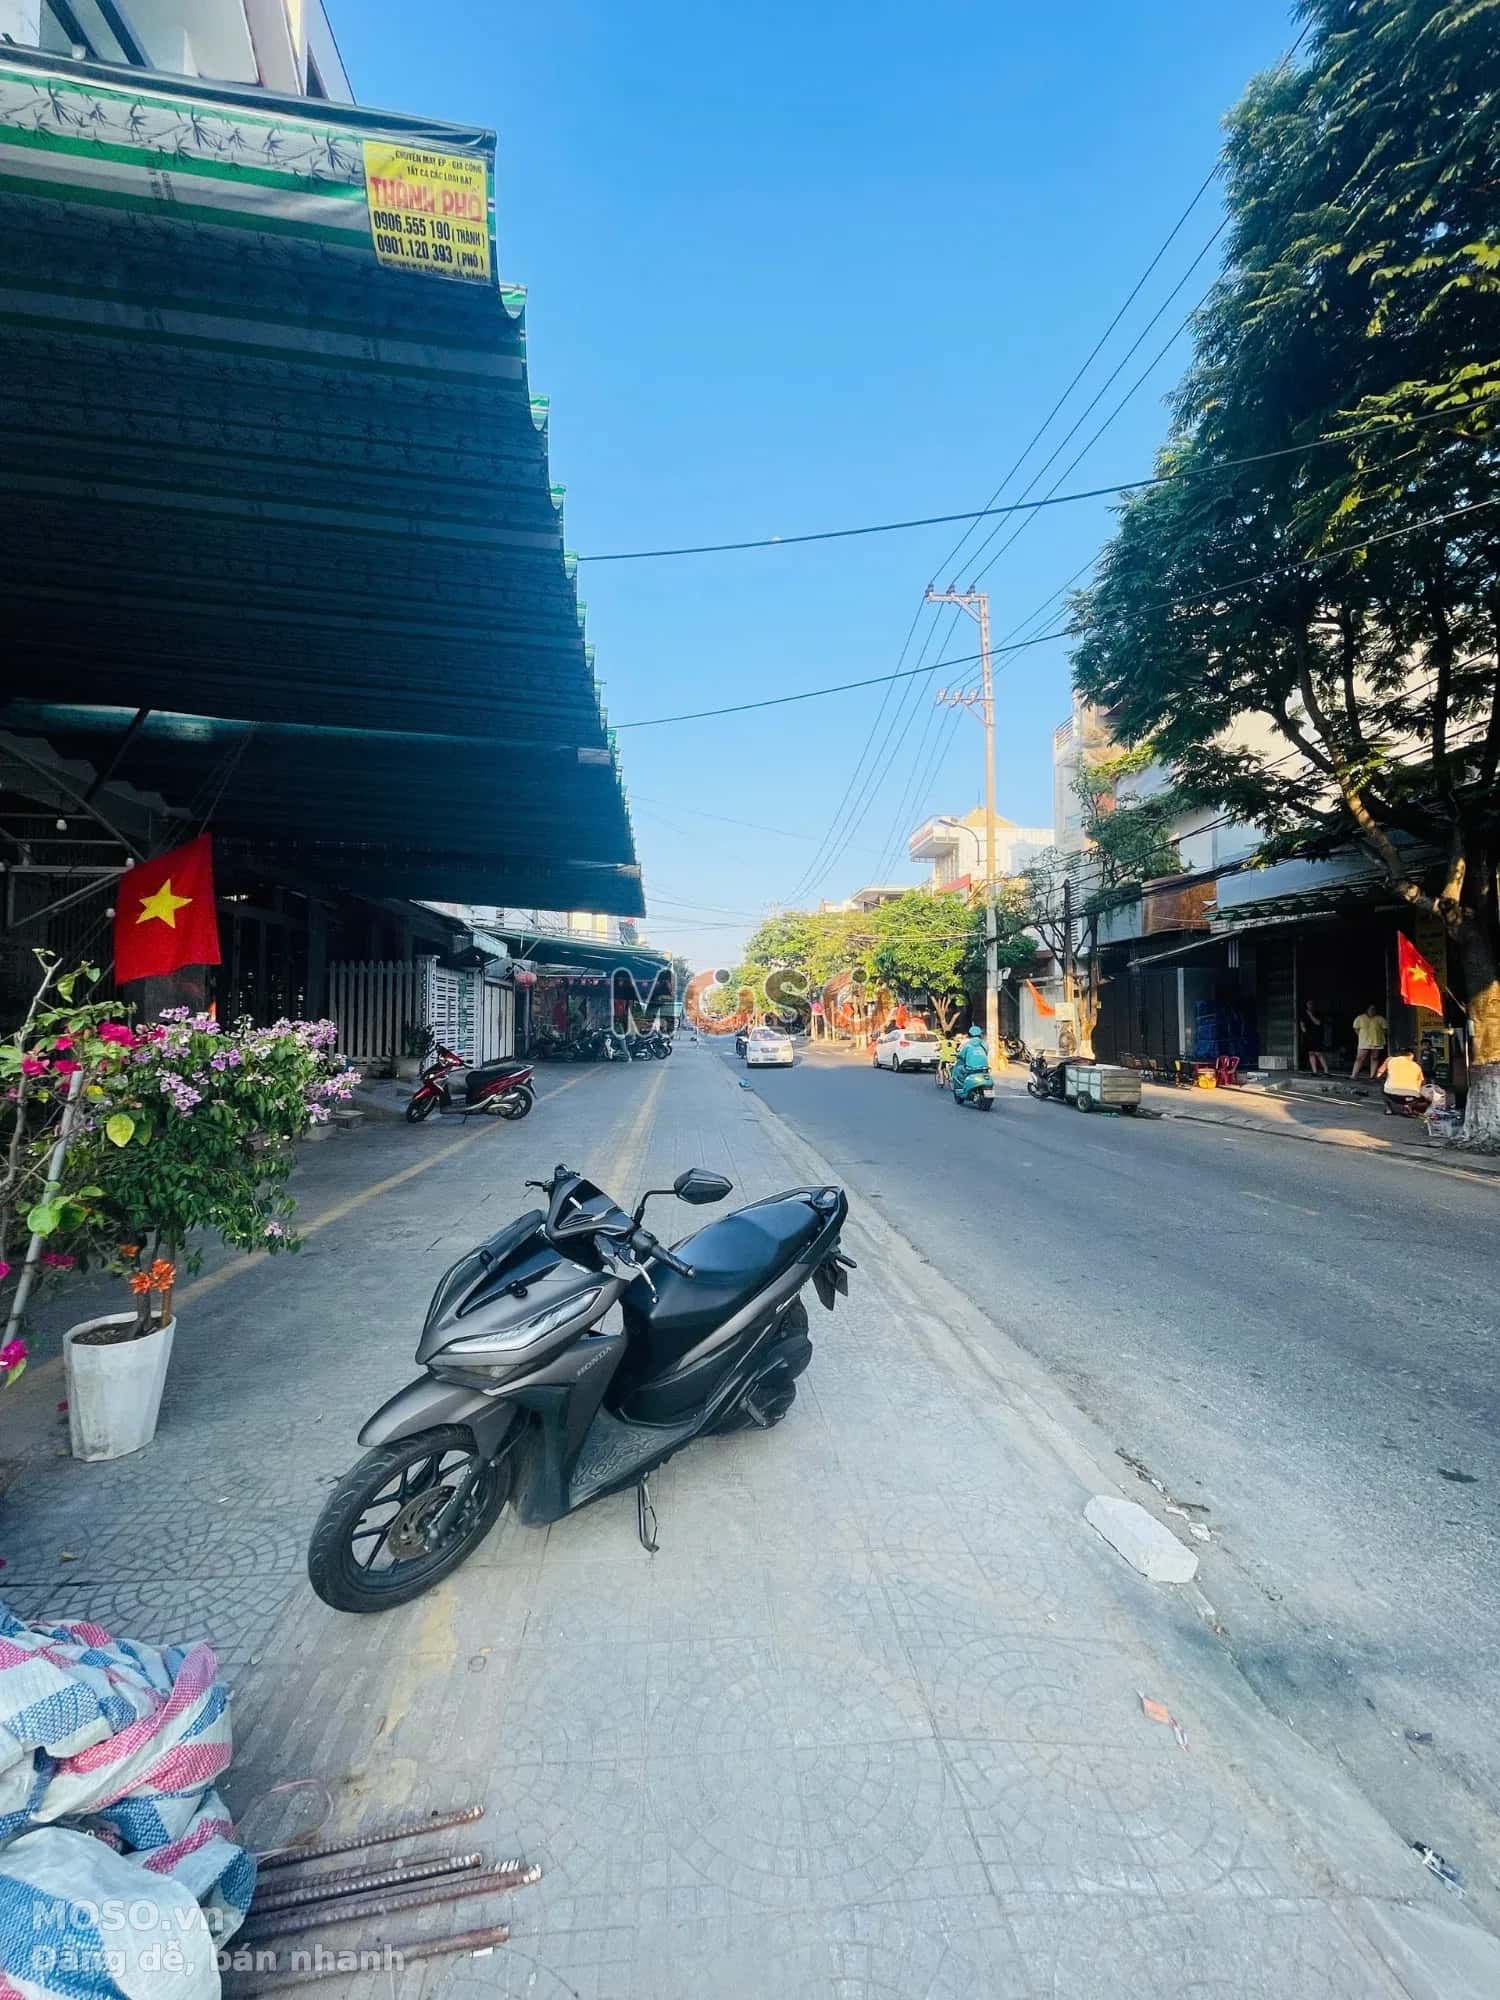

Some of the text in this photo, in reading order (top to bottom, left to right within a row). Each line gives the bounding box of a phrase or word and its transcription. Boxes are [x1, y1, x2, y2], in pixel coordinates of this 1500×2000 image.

[374, 210, 426, 236] 0906.555
[429, 220, 450, 240] 190
[377, 234, 429, 260] 0901.120
[431, 242, 453, 264] 393
[576, 1346, 612, 1377] HONDA
